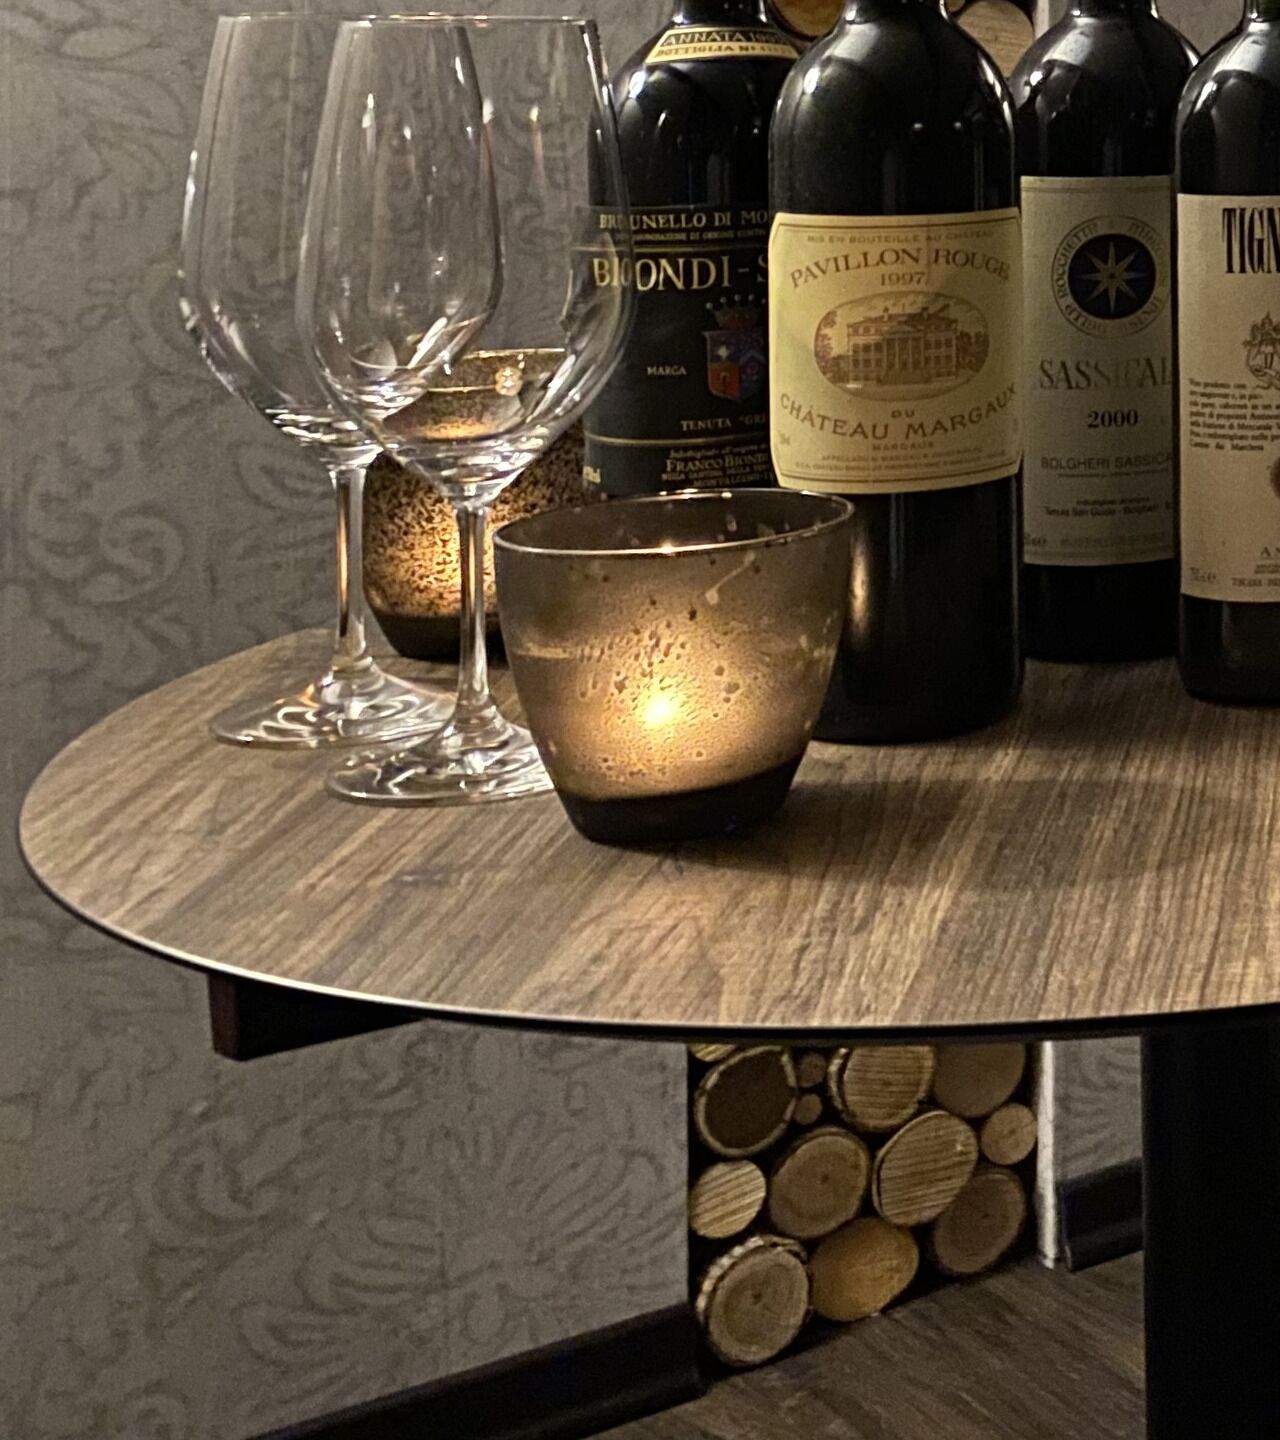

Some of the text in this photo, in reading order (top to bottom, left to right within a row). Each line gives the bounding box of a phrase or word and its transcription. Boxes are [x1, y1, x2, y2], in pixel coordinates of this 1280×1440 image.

[664, 31, 746, 47] ANNATA
[715, 211, 732, 226] DI
[790, 247, 1010, 289] PAVILLON ROUGE
[881, 271, 926, 287] 1997
[646, 365, 687, 377] MARCA
[891, 409, 916, 419] DU
[905, 383, 1018, 441] MARGAUX
[1087, 409, 1139, 429] 2000
[681, 418, 732, 431] TENUTA
[666, 455, 725, 473] FRANCO
[1041, 456, 1110, 470] BOLGHERI
